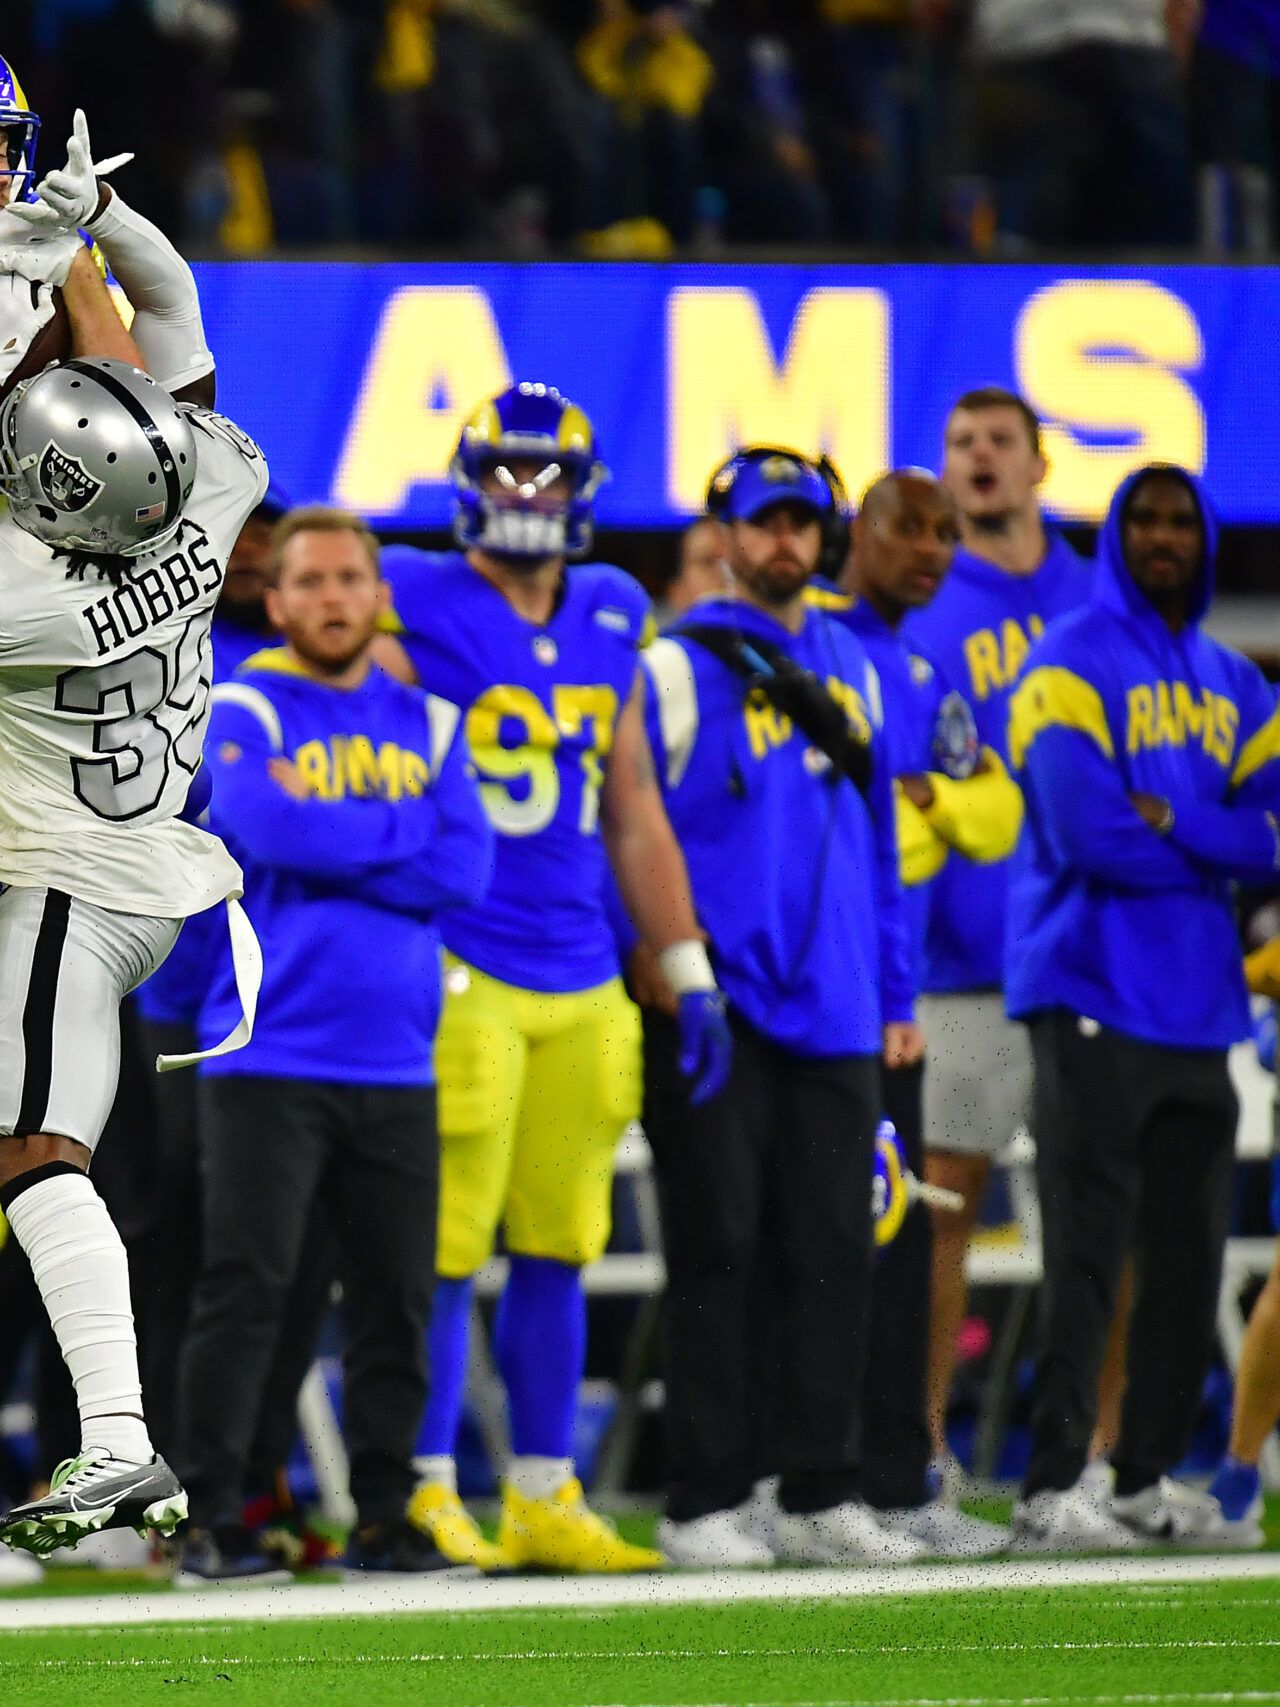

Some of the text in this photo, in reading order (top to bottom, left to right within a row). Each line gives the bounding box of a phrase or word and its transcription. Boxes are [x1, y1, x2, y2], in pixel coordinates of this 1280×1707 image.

[107, 279, 1208, 521] AMS
[49, 450, 95, 490] RAIDERS
[82, 534, 223, 657] HOBBS
[465, 683, 619, 836] 97
[1126, 680, 1239, 765] RAMS
